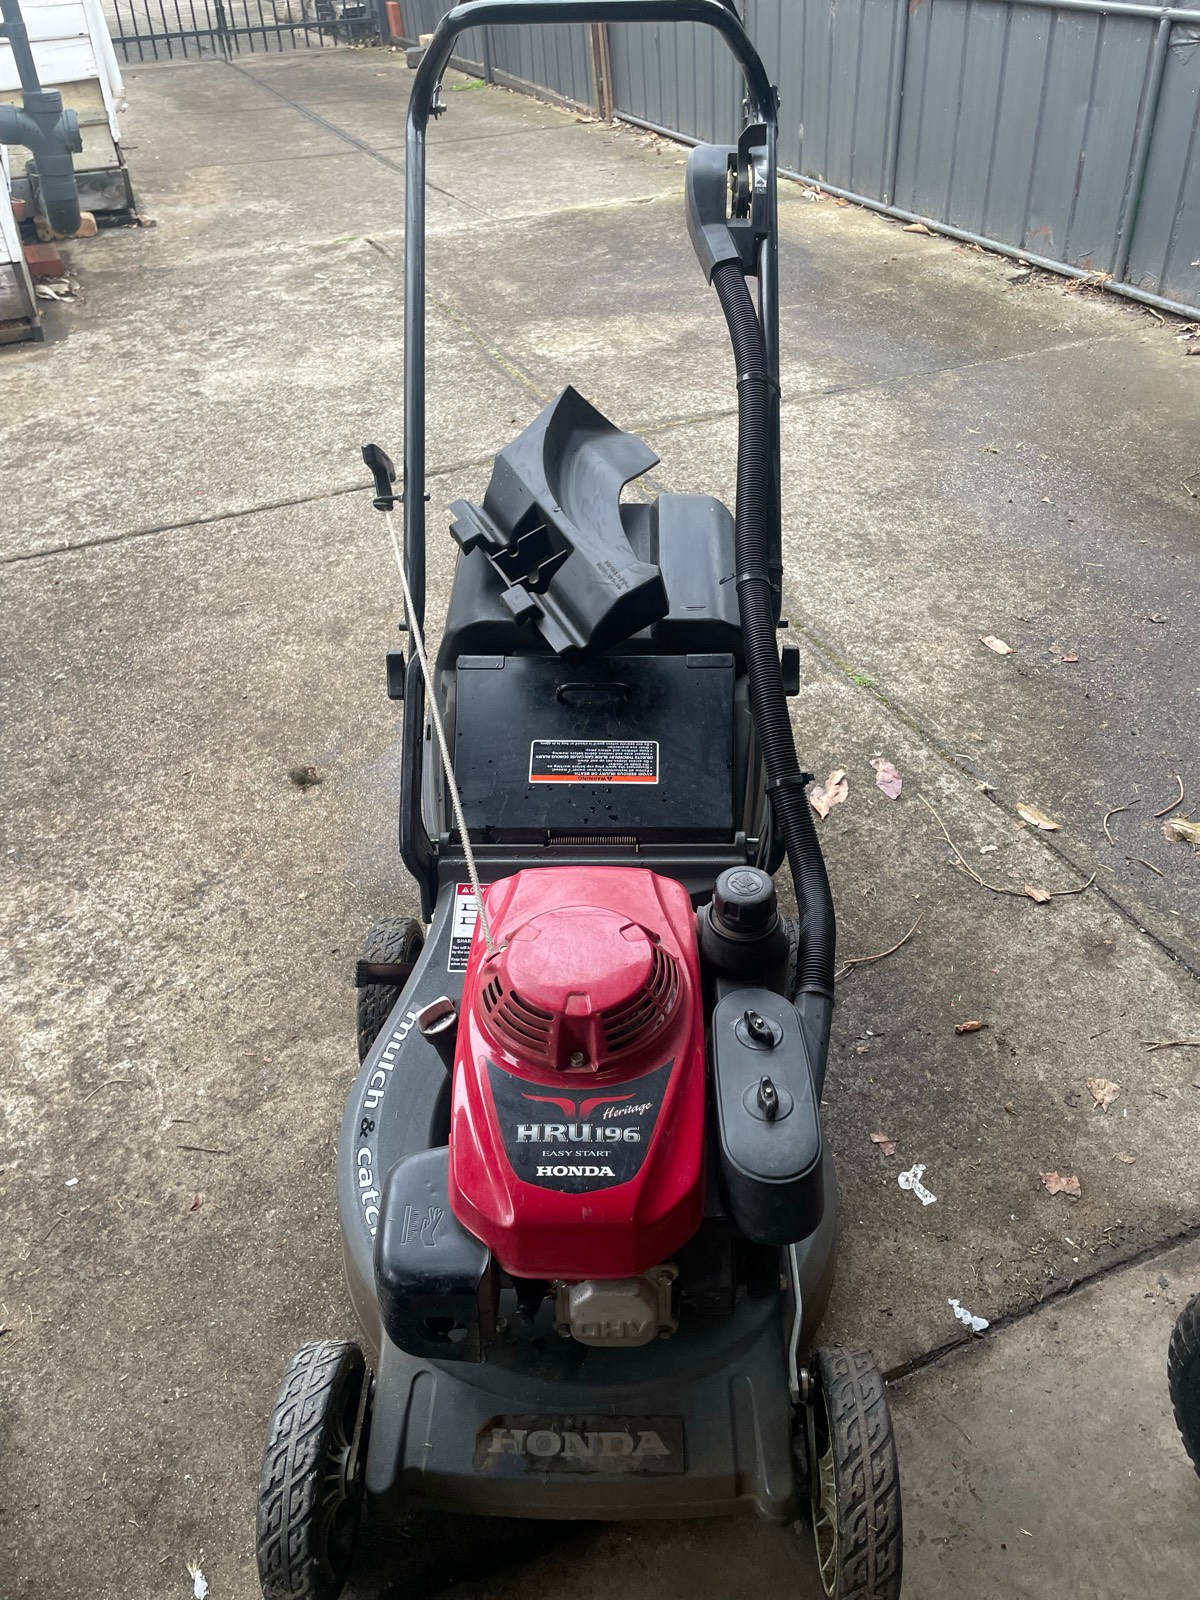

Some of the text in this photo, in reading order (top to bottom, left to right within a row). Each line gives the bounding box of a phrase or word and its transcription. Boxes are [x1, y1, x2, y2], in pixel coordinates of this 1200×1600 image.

[363, 1011, 416, 1109] mulch
[602, 1102, 653, 1120] Heritage
[359, 1118, 375, 1138] &
[515, 1123, 641, 1144] HRU196
[536, 1165, 616, 1177] HONDA
[577, 1320, 647, 1338] OHV
[487, 1428, 672, 1457] HONDA
